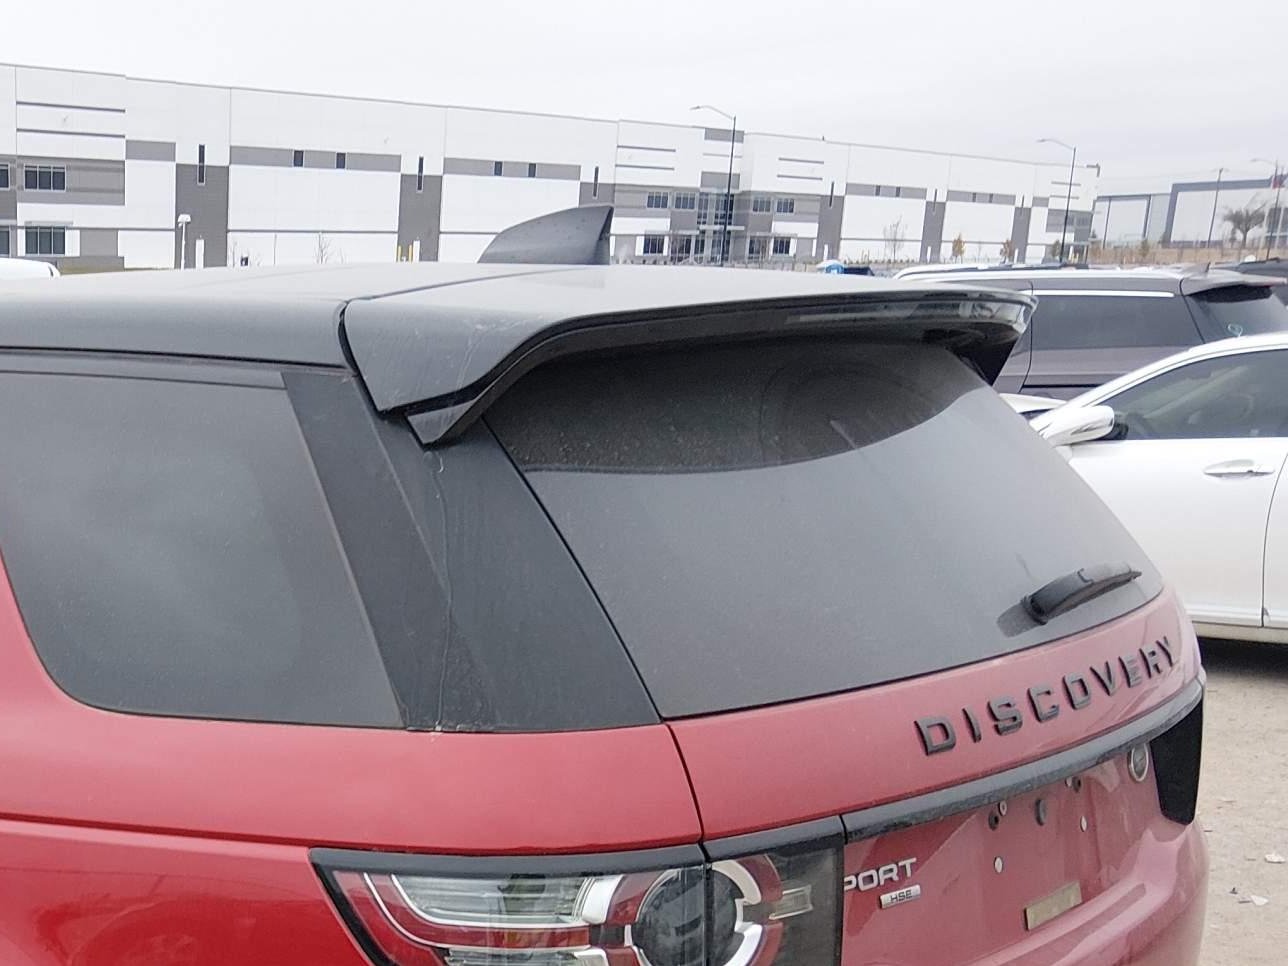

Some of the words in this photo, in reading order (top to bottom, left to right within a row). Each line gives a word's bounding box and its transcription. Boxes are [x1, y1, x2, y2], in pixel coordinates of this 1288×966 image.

[914, 635, 1176, 757] DISCOVERY
[844, 857, 917, 892] PORT
[890, 889, 913, 904] HSE
